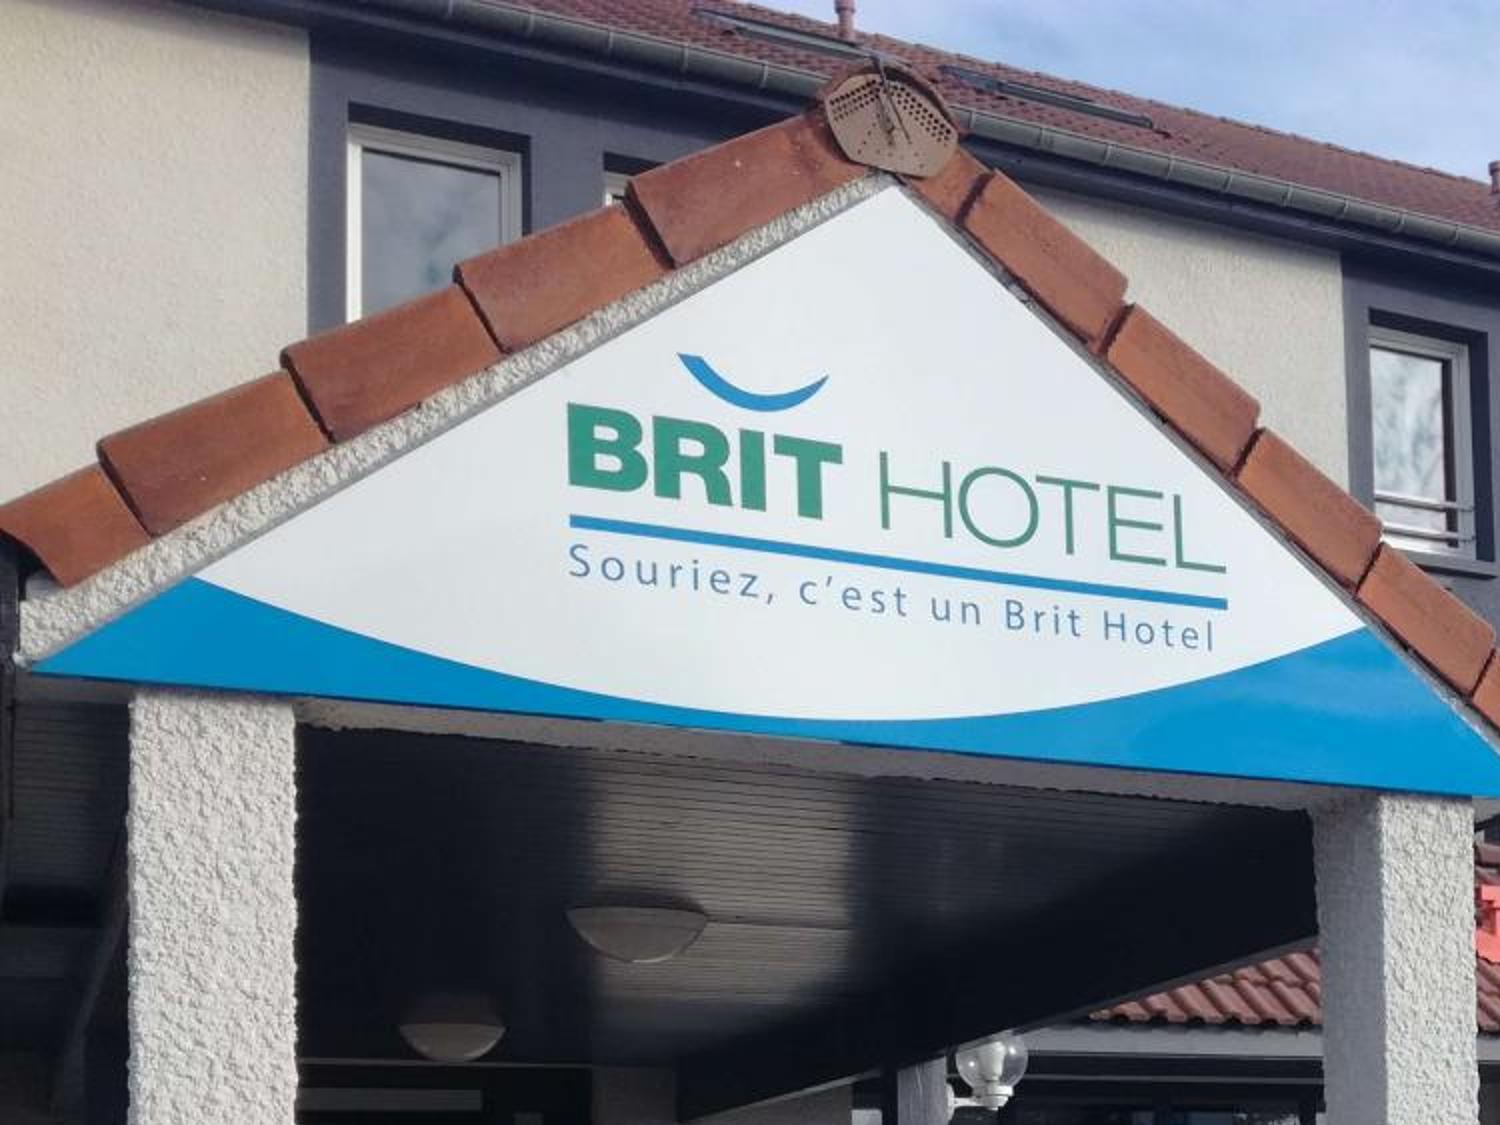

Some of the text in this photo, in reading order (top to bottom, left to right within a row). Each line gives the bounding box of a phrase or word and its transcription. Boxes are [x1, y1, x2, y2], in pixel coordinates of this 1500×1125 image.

[566, 401, 1228, 575] BRIT HOTEL
[568, 543, 775, 605] Souriez,
[930, 597, 982, 625] un
[1005, 599, 1081, 638] Brit
[1103, 610, 1214, 652] Hotel
